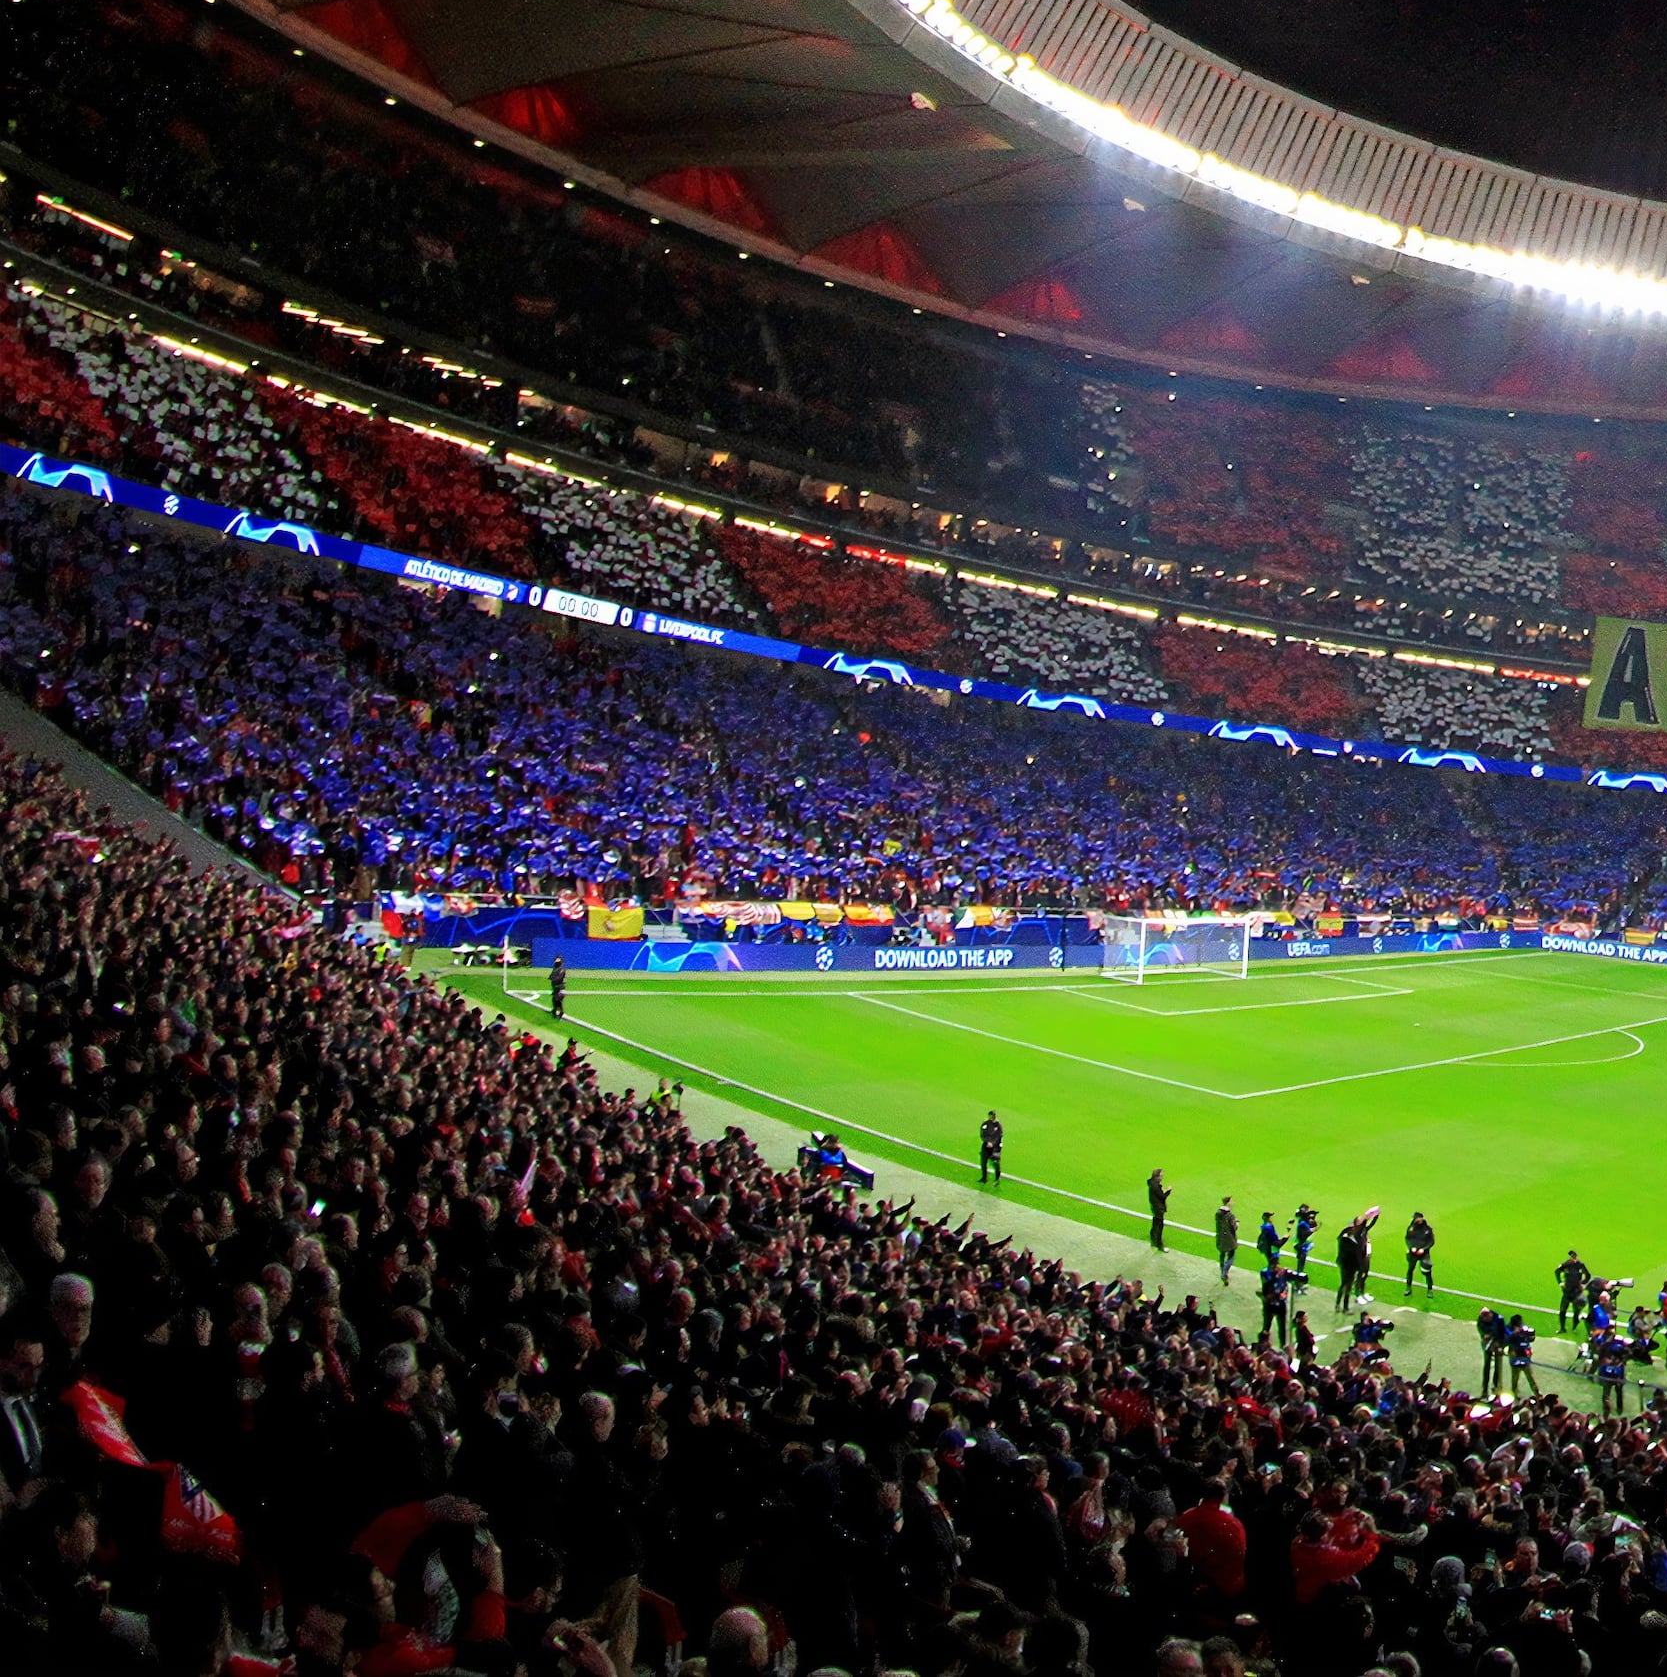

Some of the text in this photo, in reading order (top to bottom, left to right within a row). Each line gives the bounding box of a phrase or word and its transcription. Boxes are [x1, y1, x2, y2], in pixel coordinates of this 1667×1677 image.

[528, 586, 542, 607] 0
[620, 607, 633, 627] 0
[1541, 936, 1615, 955] DOWNLOAD
[1616, 946, 1641, 960] THE
[874, 949, 1014, 968] DOWNLOAD THE APP
